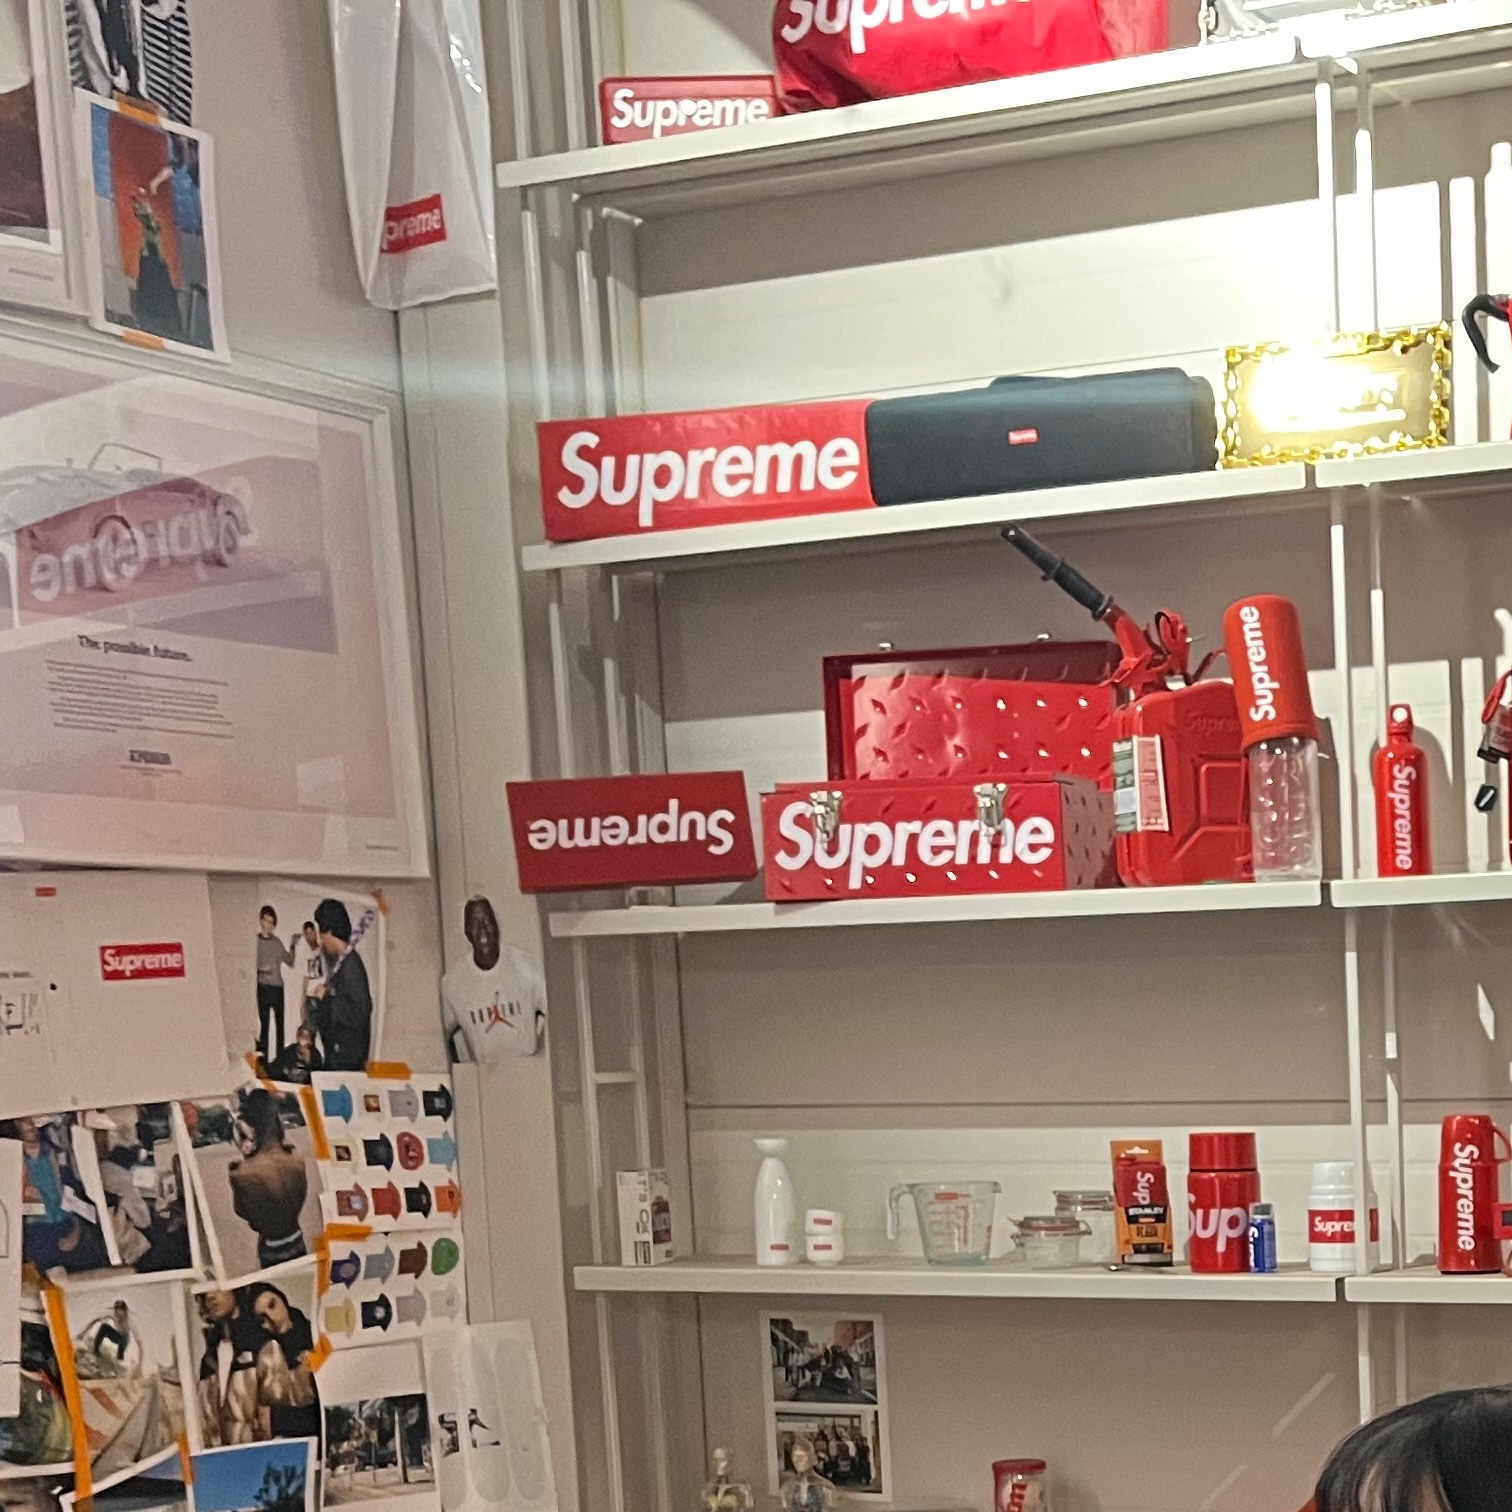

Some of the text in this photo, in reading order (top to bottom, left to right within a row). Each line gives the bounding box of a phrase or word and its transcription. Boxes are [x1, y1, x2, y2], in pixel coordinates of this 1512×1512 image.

[610, 88, 770, 138] Supreme
[558, 431, 859, 526] Supreme
[1239, 605, 1281, 722] Supreme
[527, 799, 735, 856] Supreme
[776, 801, 1055, 889] Supreme
[1386, 764, 1417, 870] Supreme
[103, 949, 183, 977] Supreme
[1132, 1171, 1154, 1205] Sup
[1449, 1142, 1479, 1251] Supreme
